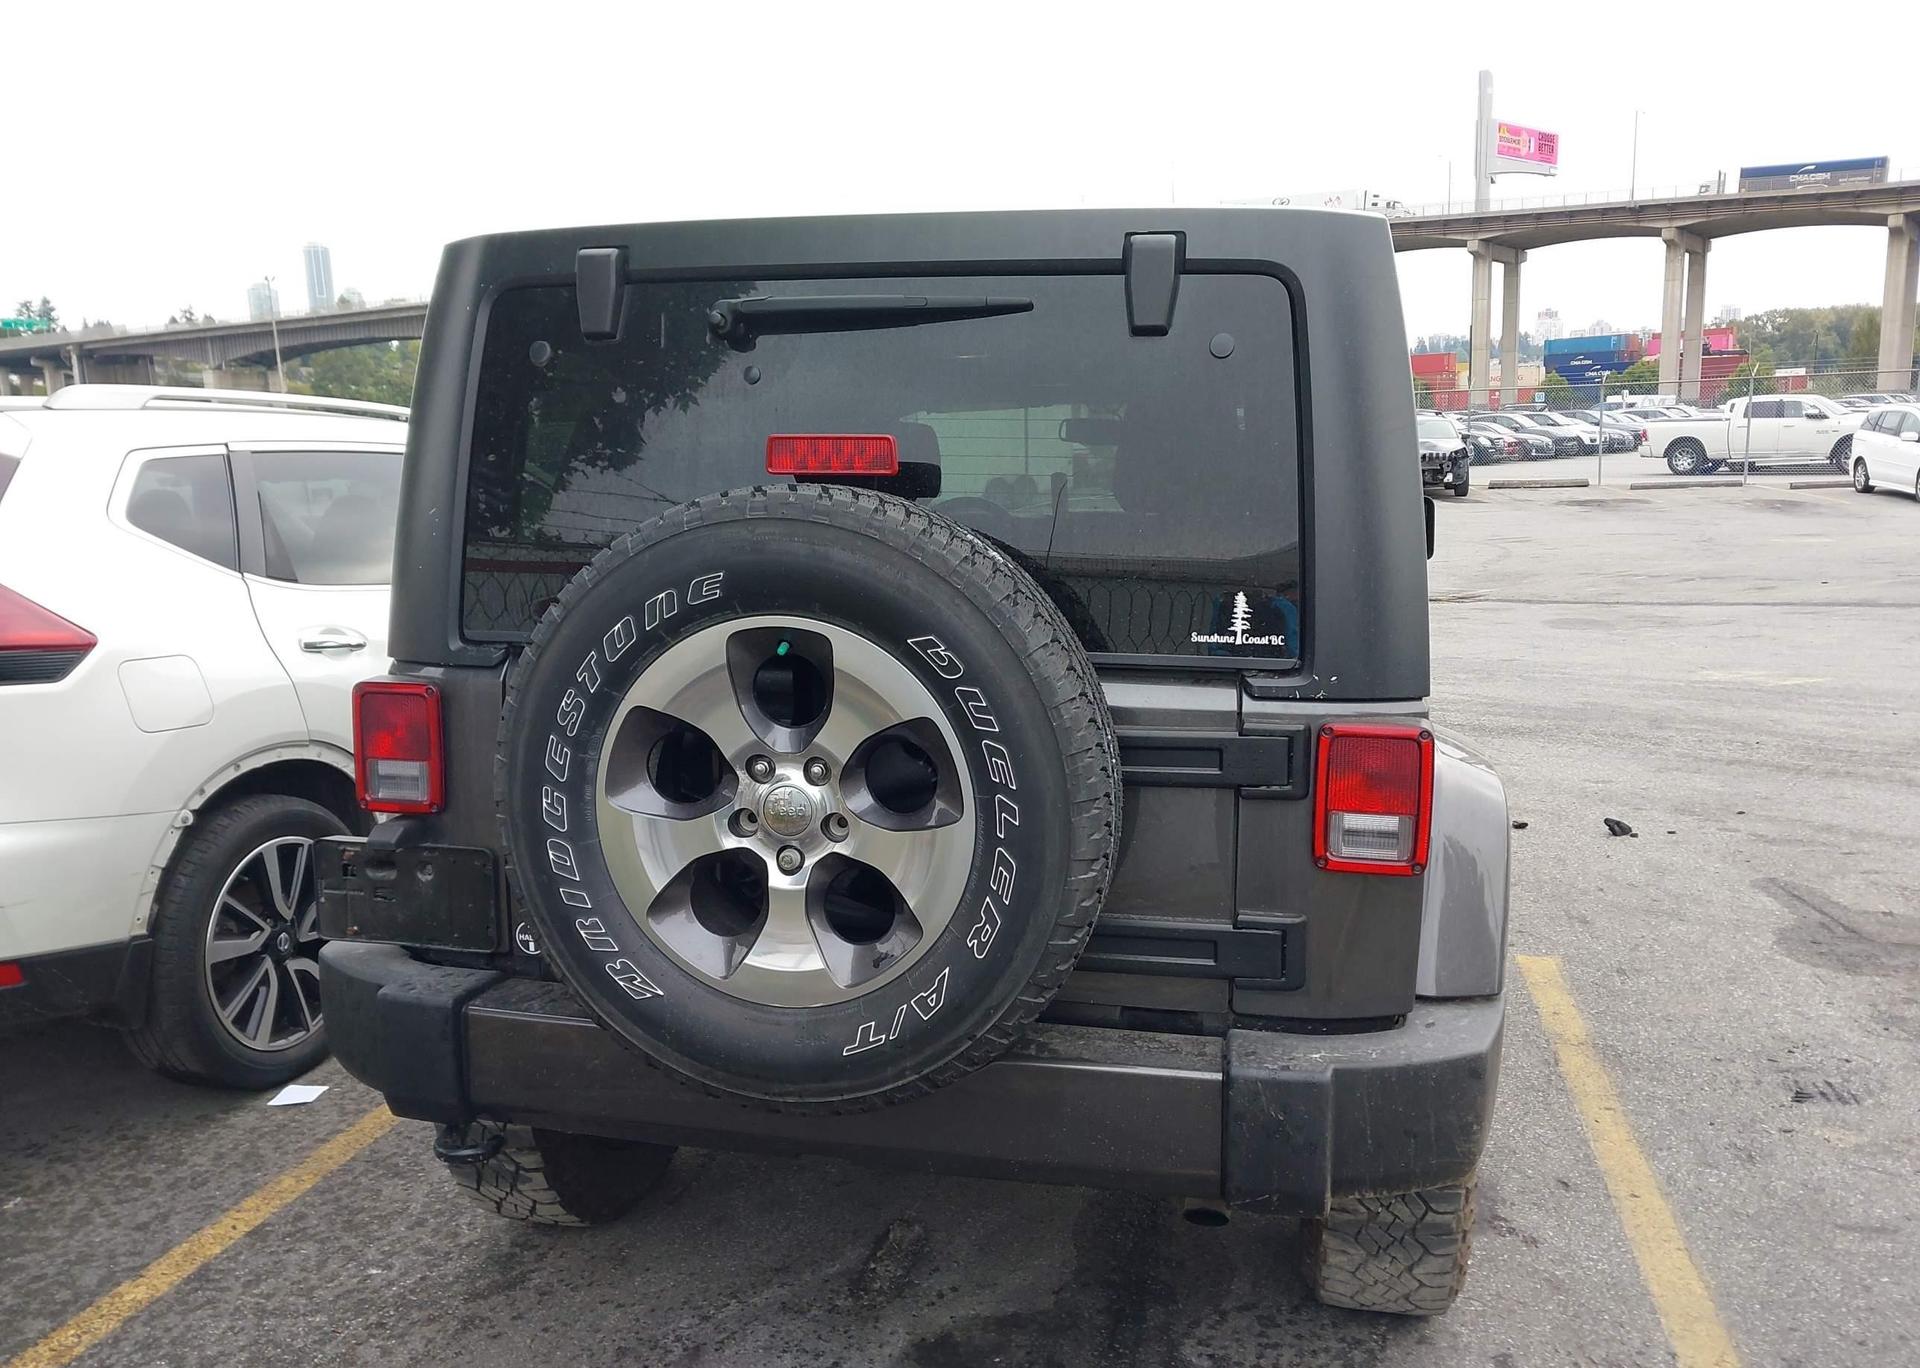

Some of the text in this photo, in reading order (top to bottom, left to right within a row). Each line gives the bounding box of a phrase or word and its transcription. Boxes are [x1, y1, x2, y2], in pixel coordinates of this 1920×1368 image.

[1538, 142, 1555, 154] BETTER
[1191, 631, 1285, 646] Sunshine Coast BC
[543, 570, 724, 1000] BRIDGESTONE
[907, 635, 1019, 960] DUELER
[842, 966, 951, 1057] A/T
